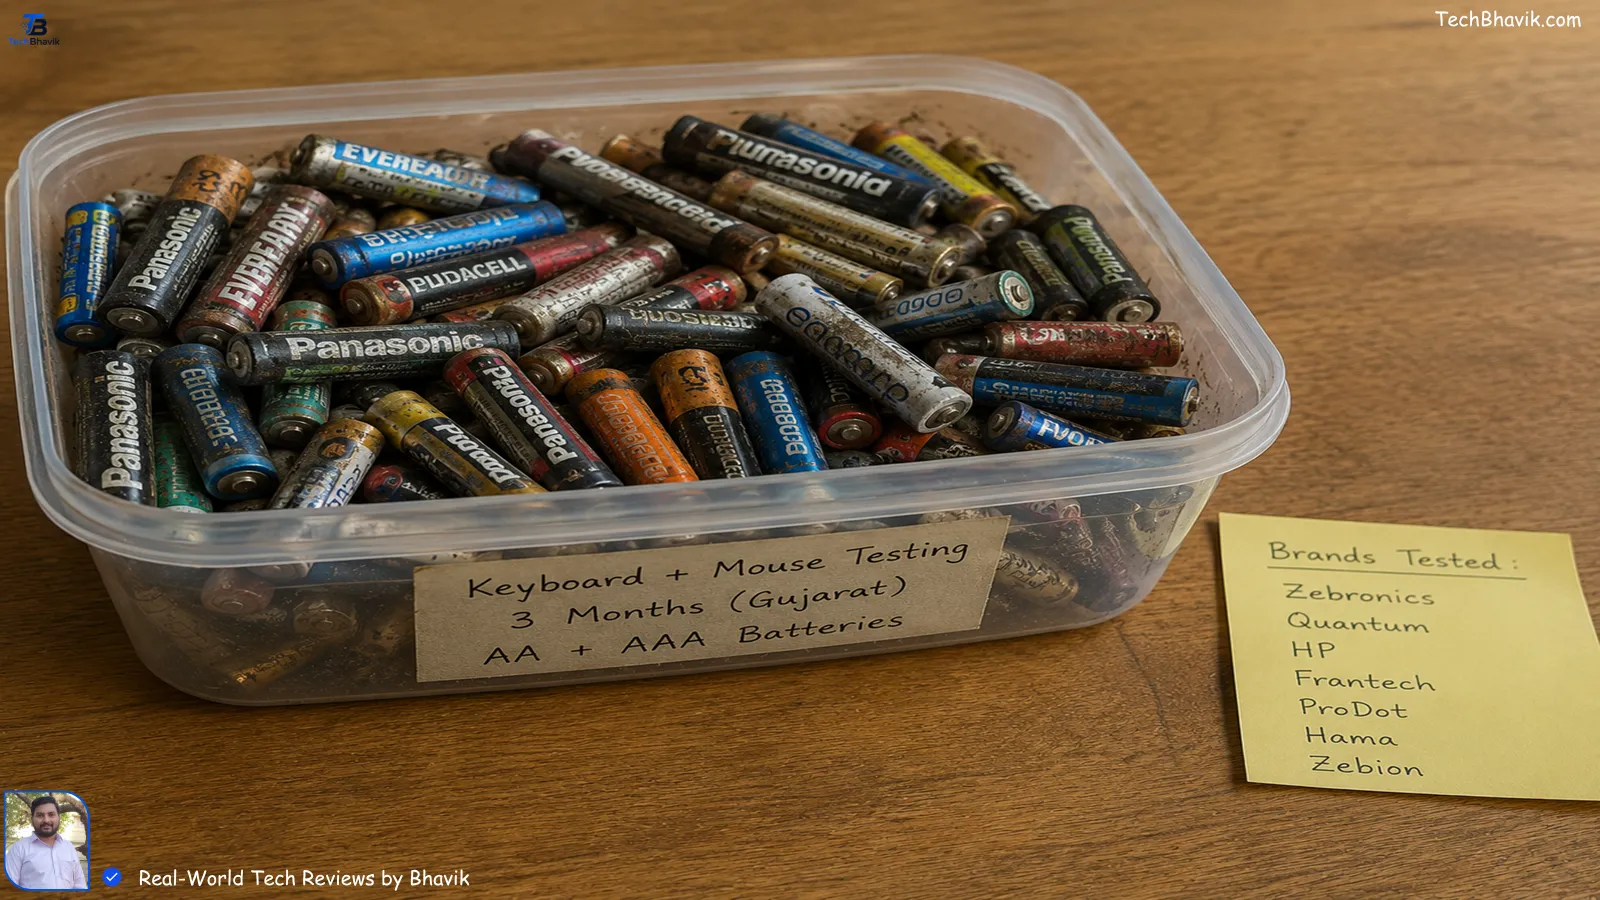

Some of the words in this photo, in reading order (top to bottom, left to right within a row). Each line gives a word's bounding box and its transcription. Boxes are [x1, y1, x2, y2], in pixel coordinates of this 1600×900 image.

[128, 207, 203, 291] Panasonic
[285, 330, 485, 361] Panasonic
[101, 360, 144, 491] Panasonic
[1268, 540, 1376, 565] Brands
[468, 566, 645, 603] Keyboard
[666, 567, 690, 583] +
[713, 556, 826, 580] Mouse
[846, 540, 970, 566] Testing
[510, 611, 534, 631] 3
[566, 600, 704, 626] Months
[730, 575, 908, 616] (Gujarat)
[1283, 583, 1436, 606] Zebronics
[1287, 611, 1430, 634] Quantum
[483, 645, 540, 666] AA
[570, 642, 593, 658] +
[621, 631, 705, 655] AAA
[739, 613, 904, 645] Batteries
[1291, 641, 1336, 659] HP
[1294, 669, 1437, 692] Frantech
[1299, 698, 1409, 720] ProDot
[1305, 726, 1399, 747] Hama
[1309, 755, 1425, 778] Zebion
